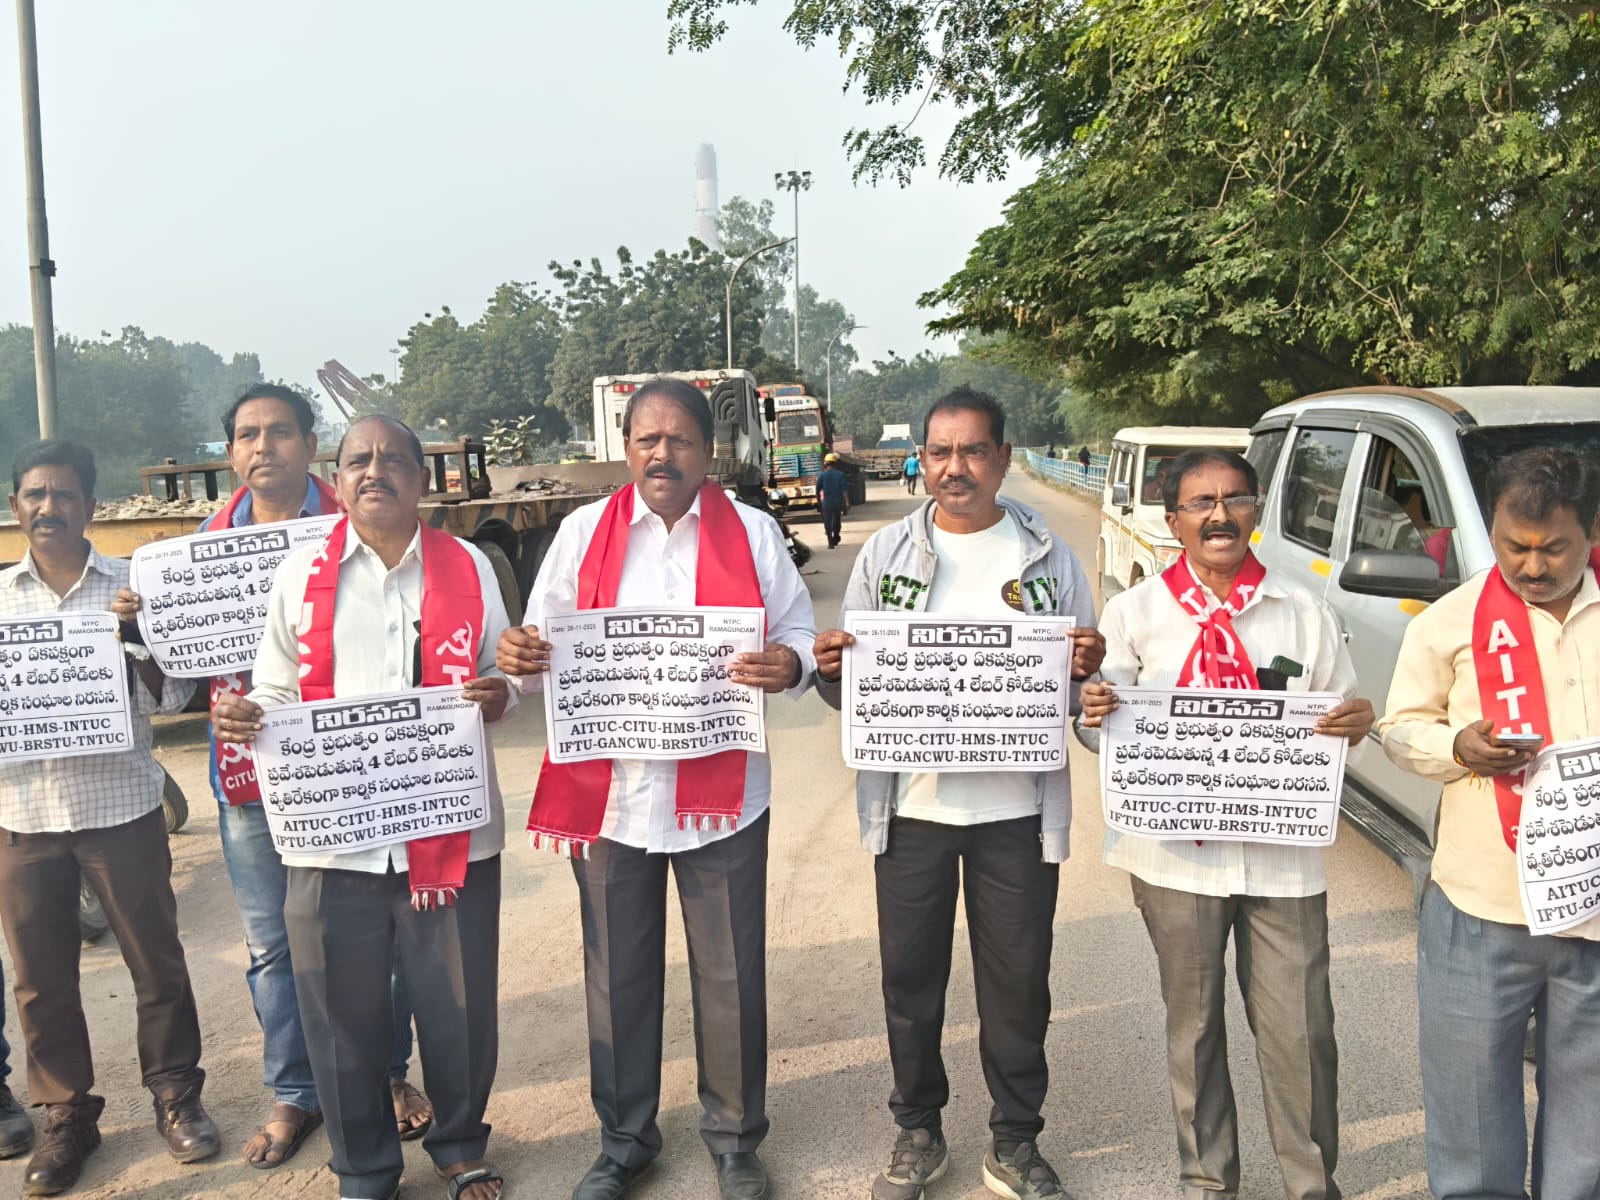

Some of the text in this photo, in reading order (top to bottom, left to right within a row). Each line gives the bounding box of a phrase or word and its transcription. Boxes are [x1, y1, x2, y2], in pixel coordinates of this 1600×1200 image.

[305, 526, 323, 534] NTPC
[193, 531, 285, 559] నిరసన
[162, 568, 195, 586] కేంద్ర
[201, 561, 252, 583] ప్రభుత్వం
[245, 584, 256, 595] 4
[68, 627, 115, 635] RAMAGUNDAM
[608, 617, 700, 636] నిరసన
[708, 625, 756, 634] RAMAGUNDAM
[912, 627, 1007, 645] నిరసన
[1017, 635, 1066, 643] RAMAGUNDAM
[29, 646, 94, 663] ఏకపక్షంగా
[573, 641, 735, 664] కేంద్ర ప్రభుత్వం ఏకపక్షంగా
[876, 648, 1043, 674] కేంద్ర ప్రభుత్వం ఏకపక్షంగా
[11, 674, 23, 686] 4
[27, 668, 59, 685] లేబర్
[654, 668, 664, 681] 4
[668, 665, 697, 682] లేబర్
[954, 679, 966, 692] 4
[970, 675, 1003, 692] లేబర్
[22, 696, 72, 710] సంఘాల
[427, 701, 476, 712] RAMAGUNDAM
[441, 696, 458, 705] NTPC
[662, 693, 710, 709] సంఘాల
[712, 689, 753, 704] నిరసన.
[1174, 698, 1279, 718] నిరసన
[1307, 704, 1327, 712] NTPC
[316, 701, 416, 730] నిరసన
[963, 706, 1013, 720] సంఘాల
[1016, 707, 1059, 718] నిరసన.
[570, 716, 745, 735] AITUC-CITU-HMS-INTUC
[1135, 717, 1168, 740] కేంద్ర
[1176, 722, 1233, 742] ప్రభుత్వం
[280, 723, 454, 758] కేంద్ర ప్రభుత్వం ఏకపక్షంగా
[559, 730, 757, 753] IFTU-GANCWU-BRSTU-TNTUC
[866, 733, 1048, 745] AITUC-CITU-HMS-INTUC
[368, 756, 381, 768] 4
[384, 747, 418, 766] లేబర్
[855, 748, 1059, 762] IFTU-GANCWU-BRSTU-TNTUC
[1217, 749, 1230, 762] 4
[1234, 746, 1270, 764] లేబర్
[225, 768, 256, 789] CITU
[379, 775, 431, 792] సంఘాల
[435, 767, 478, 784] నిరసన.
[1225, 774, 1279, 791] సంఘాల
[1283, 777, 1329, 791] నిరసన.
[1535, 786, 1568, 811] కేంద్ర
[284, 795, 470, 831] AITUC-CITU-HMS-INTUC
[1121, 800, 1316, 819] AITUC-CITU-HMS-INTUC
[277, 808, 482, 847] IFTU-GANCWU-BRSTU-TNTUC
[1110, 809, 1328, 836] IFTU-GANCWU-BRSTU-TNTUC
